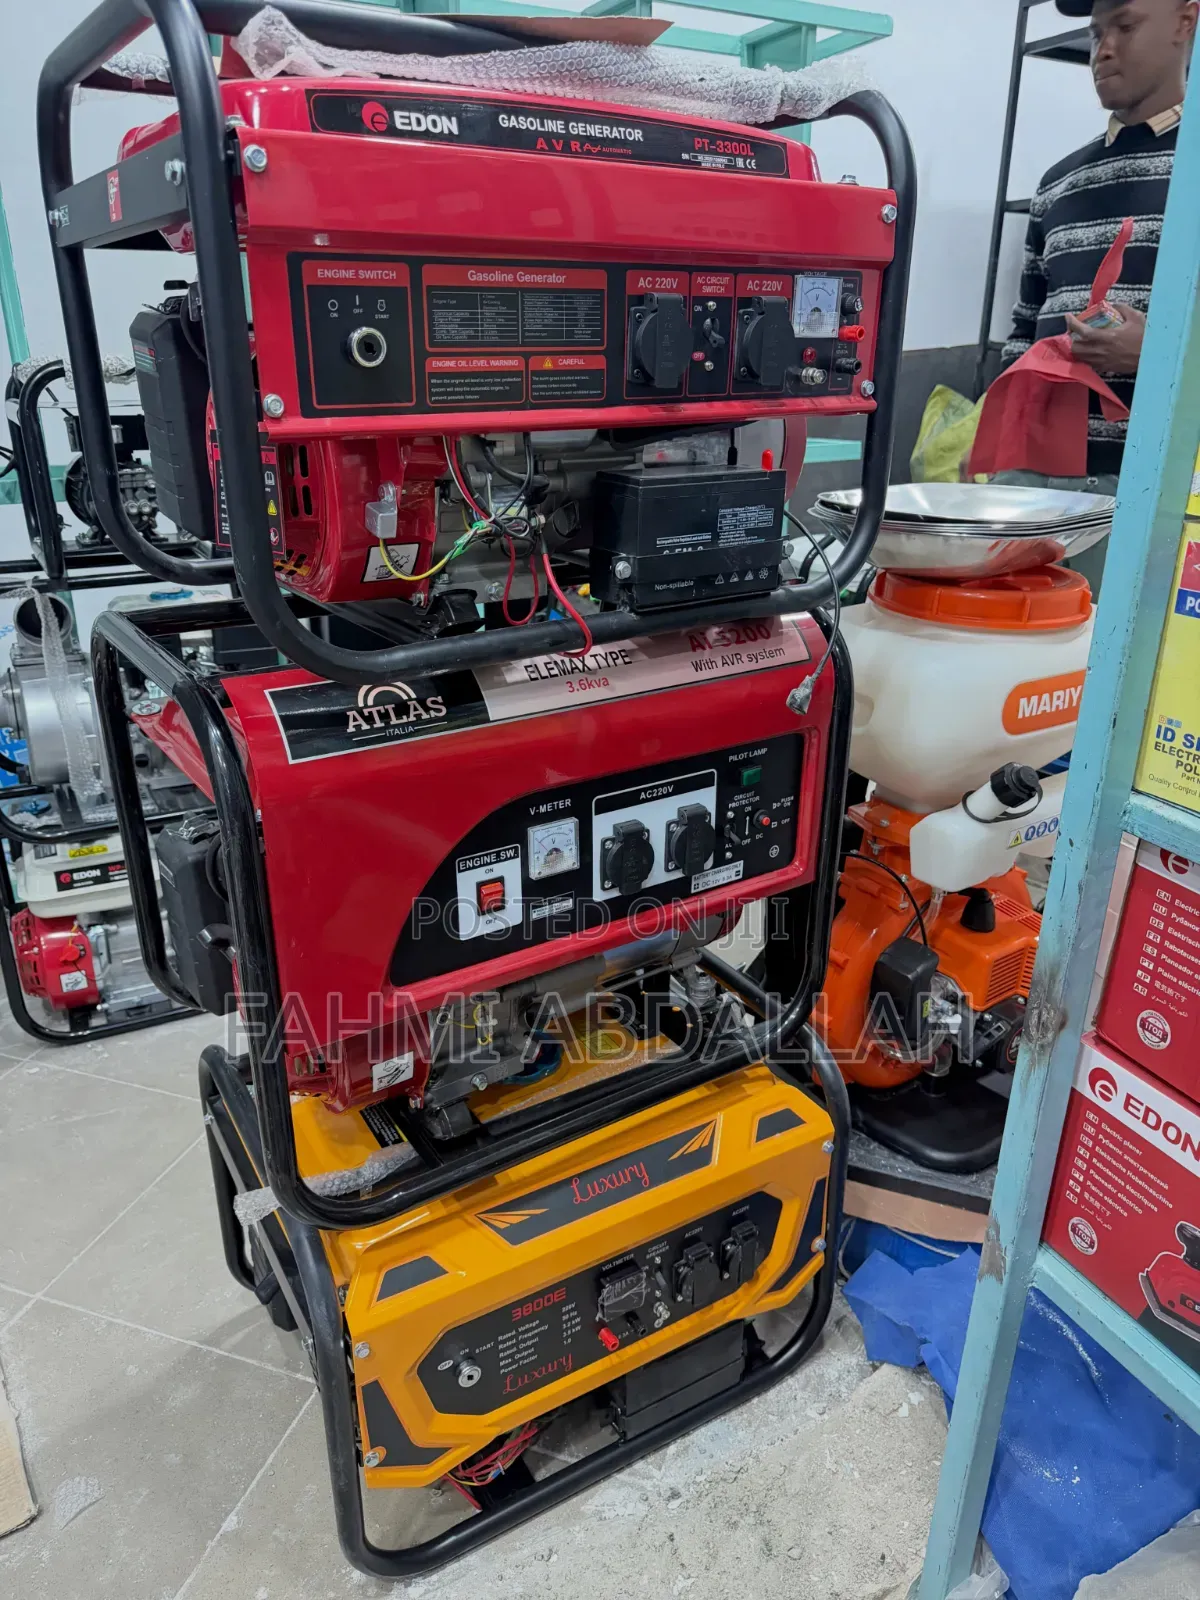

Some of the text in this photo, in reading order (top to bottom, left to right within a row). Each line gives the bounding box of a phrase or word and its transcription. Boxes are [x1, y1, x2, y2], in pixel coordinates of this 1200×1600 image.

[393, 110, 459, 135] EDON
[498, 114, 644, 142] GASOLINE GENERATOR
[694, 137, 755, 156] PT-3300L
[317, 268, 397, 279] ENGINE SWITCH
[467, 269, 566, 284] Gasoline Generator
[696, 276, 730, 284] AC CIRCUIT
[638, 277, 678, 289] AC 220V
[702, 285, 725, 293] SWITCH
[747, 280, 782, 291] AC 220V
[654, 581, 694, 591] Non-spillable
[523, 648, 633, 682] ELEMAX TYPE
[691, 645, 786, 673] With AVR system
[565, 675, 610, 694] 3.6kva
[346, 695, 447, 733] ATLAS
[385, 725, 415, 737] ITALIA
[1155, 724, 1176, 743] ID
[728, 748, 768, 762] PILOT LAMP
[1181, 772, 1196, 783] Part
[1148, 773, 1197, 797] Quality Control
[640, 785, 674, 800] AC220V
[733, 791, 755, 801] CIRCUIT
[529, 798, 572, 816] V-METER
[728, 795, 760, 809] PROTECTOR
[741, 838, 751, 846] OFF
[459, 848, 518, 871] ENGINE.SW.
[73, 869, 101, 880] EDON
[1153, 903, 1167, 916] RU
[1157, 890, 1200, 917] EN Electric
[1150, 917, 1164, 930] DE
[1146, 930, 1160, 943] FR
[1143, 943, 1193, 976] ES Planeador
[1137, 970, 1151, 983] JP
[1140, 957, 1154, 970] PT
[1157, 966, 1178, 982] Plaina
[1133, 982, 1147, 996] AR
[1083, 1122, 1096, 1136] RU
[1086, 1111, 1143, 1156] EN Electric planer
[1123, 1092, 1200, 1162] EDON
[1077, 1146, 1090, 1159] FR
[1098, 1133, 1169, 1190] Рубанок электрический
[1080, 1134, 1093, 1147] DE
[1095, 1146, 1127, 1173] Elektrische
[1127, 1169, 1173, 1209] Hobelmaschine
[570, 1161, 650, 1205] Luxury
[1086, 1179, 1103, 1197] Plaina
[1089, 1169, 1117, 1194] Planeador
[1065, 1190, 1078, 1204] AR
[647, 1240, 668, 1253] CIRCUIT
[601, 1253, 635, 1271] VOLTMETER
[511, 1287, 567, 1322] 3800E
[518, 1320, 540, 1332] Voltage
[518, 1324, 549, 1341] Frequency
[475, 1341, 495, 1354] START
[518, 1336, 540, 1349] Output
[460, 1347, 470, 1355] ON
[514, 1347, 535, 1359] Output
[439, 1361, 452, 1370] OFF
[500, 1363, 519, 1374] Power
[519, 1354, 538, 1366] Factor
[502, 1352, 573, 1395] Luxury
